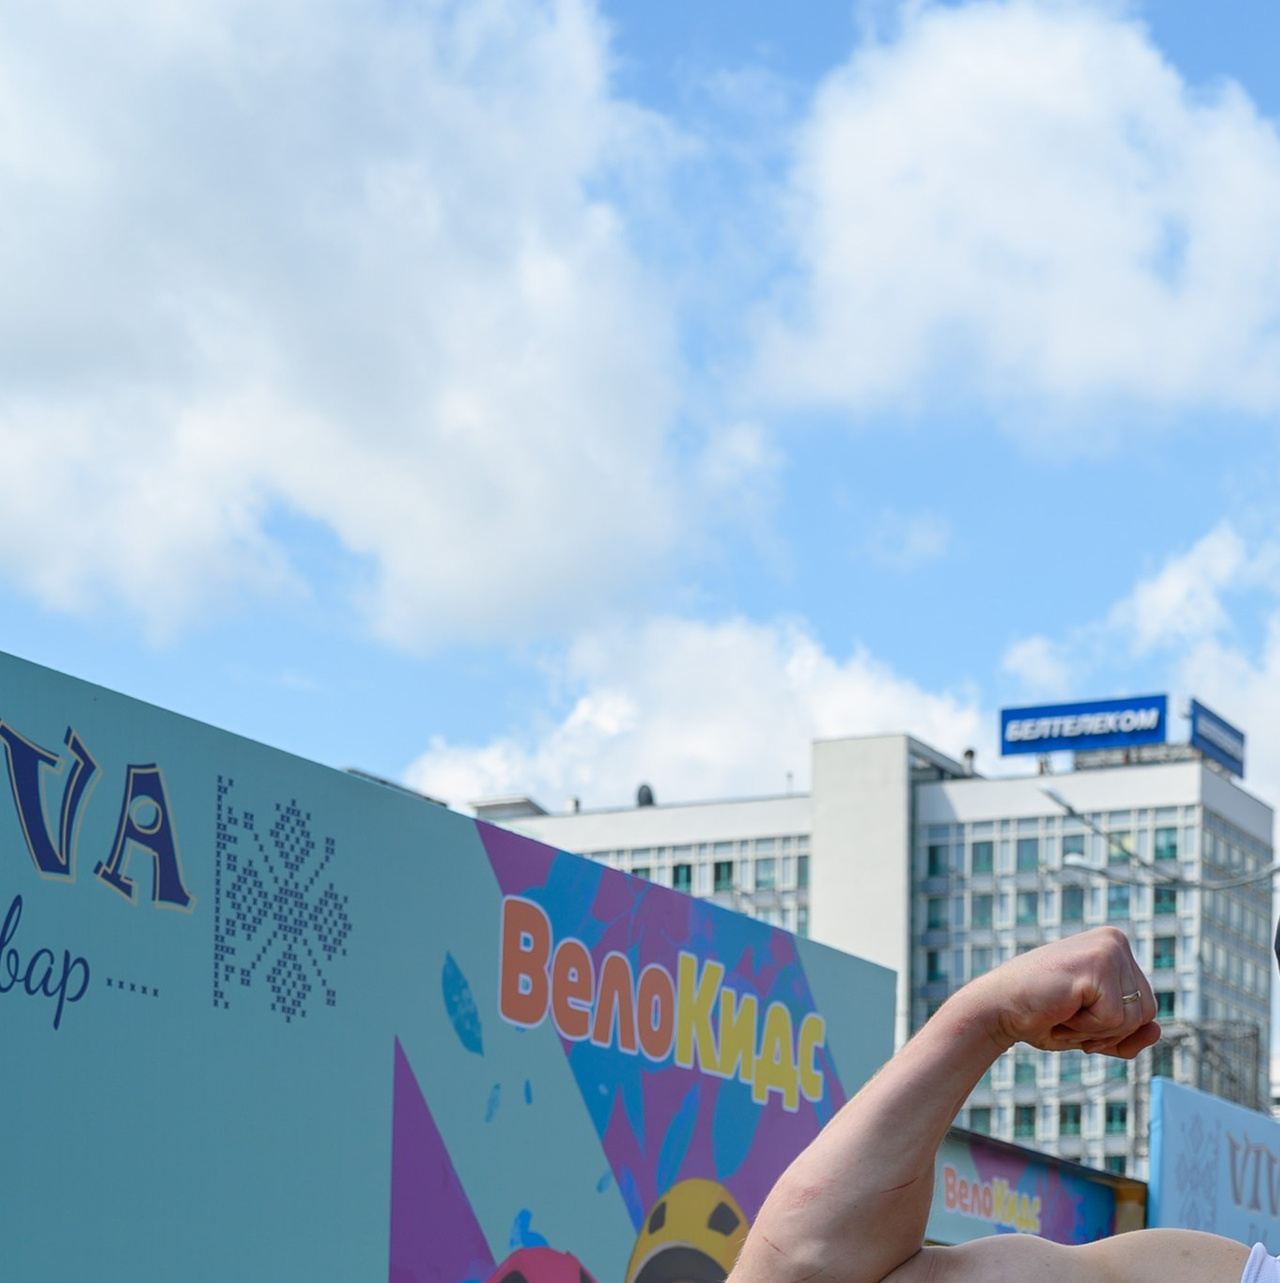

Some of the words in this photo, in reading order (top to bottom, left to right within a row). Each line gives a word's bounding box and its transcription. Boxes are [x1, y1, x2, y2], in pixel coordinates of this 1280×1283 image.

[1005, 707, 1160, 742] БЕЛТЕЛЕКОМ
[500, 896, 825, 1111] ВелоКидс
[942, 1166, 1042, 1234] ВелоКидс
